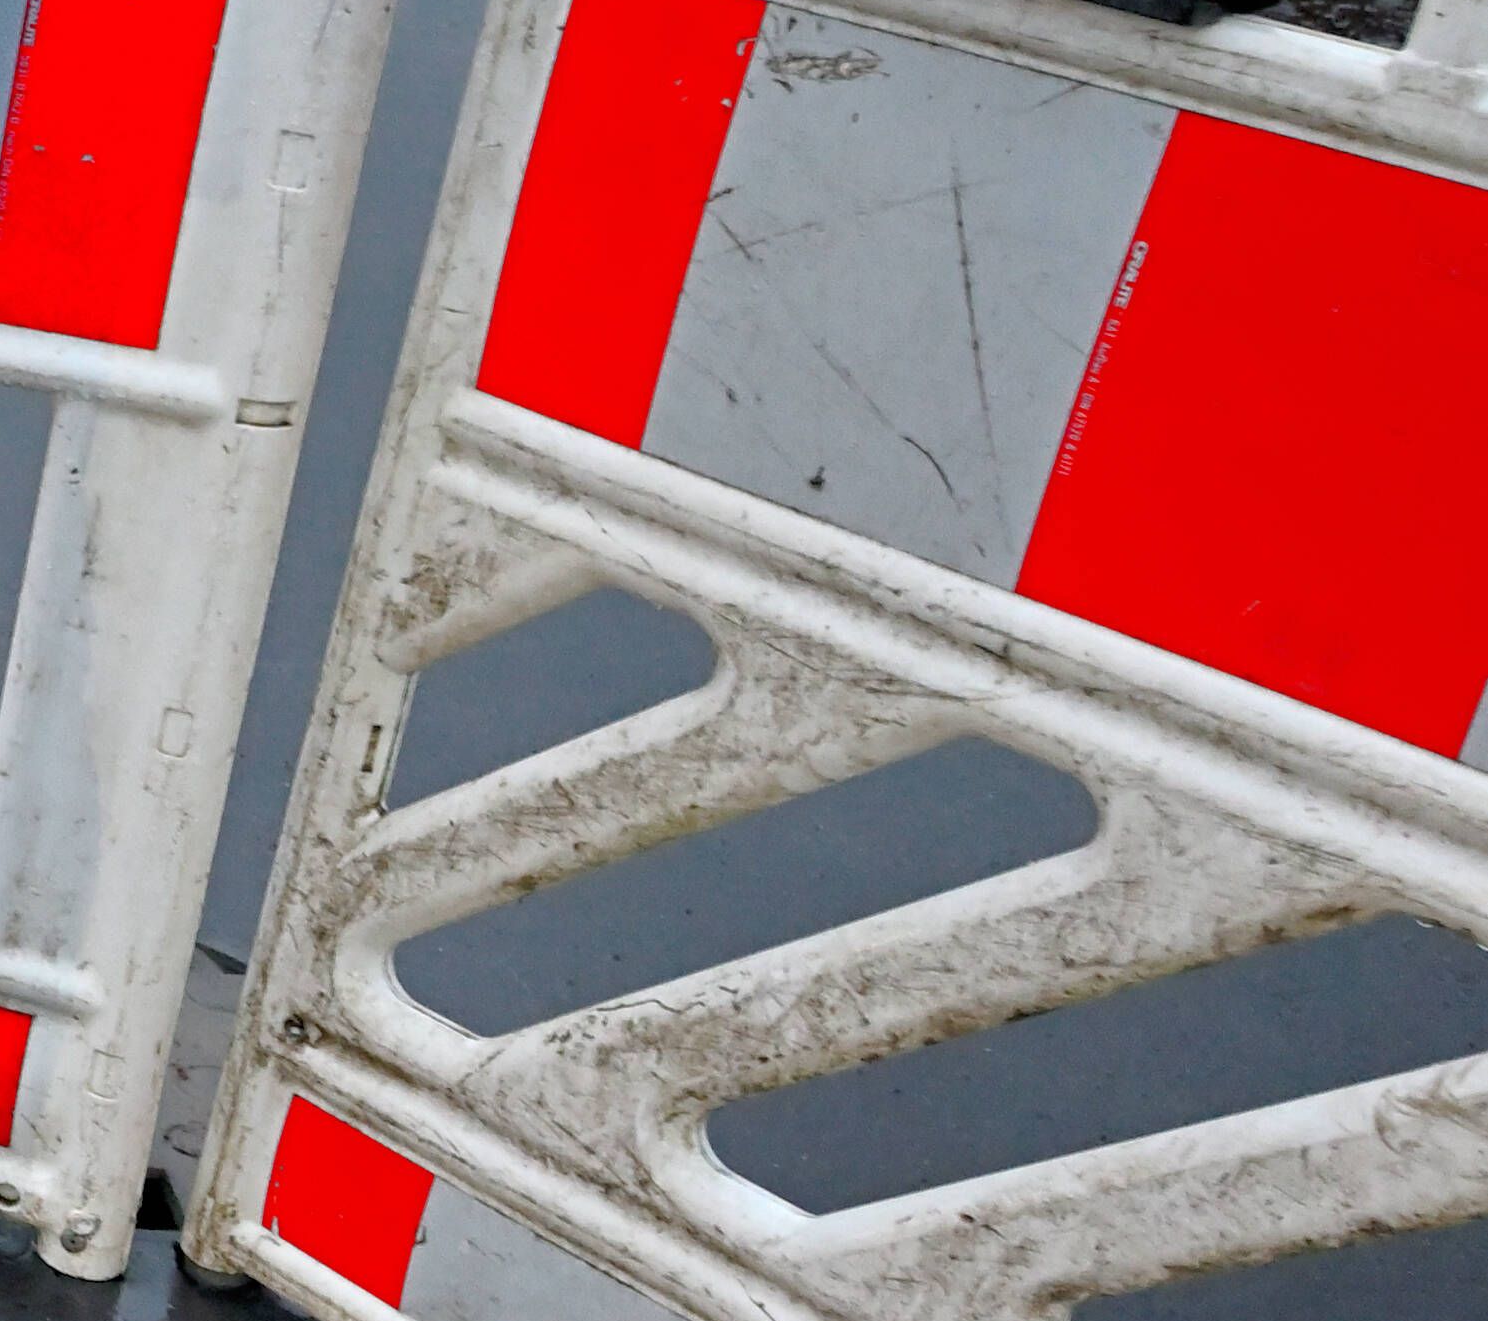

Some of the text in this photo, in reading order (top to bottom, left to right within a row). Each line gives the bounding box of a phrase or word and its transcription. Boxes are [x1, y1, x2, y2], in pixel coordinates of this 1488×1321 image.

[1114, 241, 1148, 309] ORALITE
[1080, 393, 1095, 410] DIN
[1068, 412, 1087, 441] 67520
